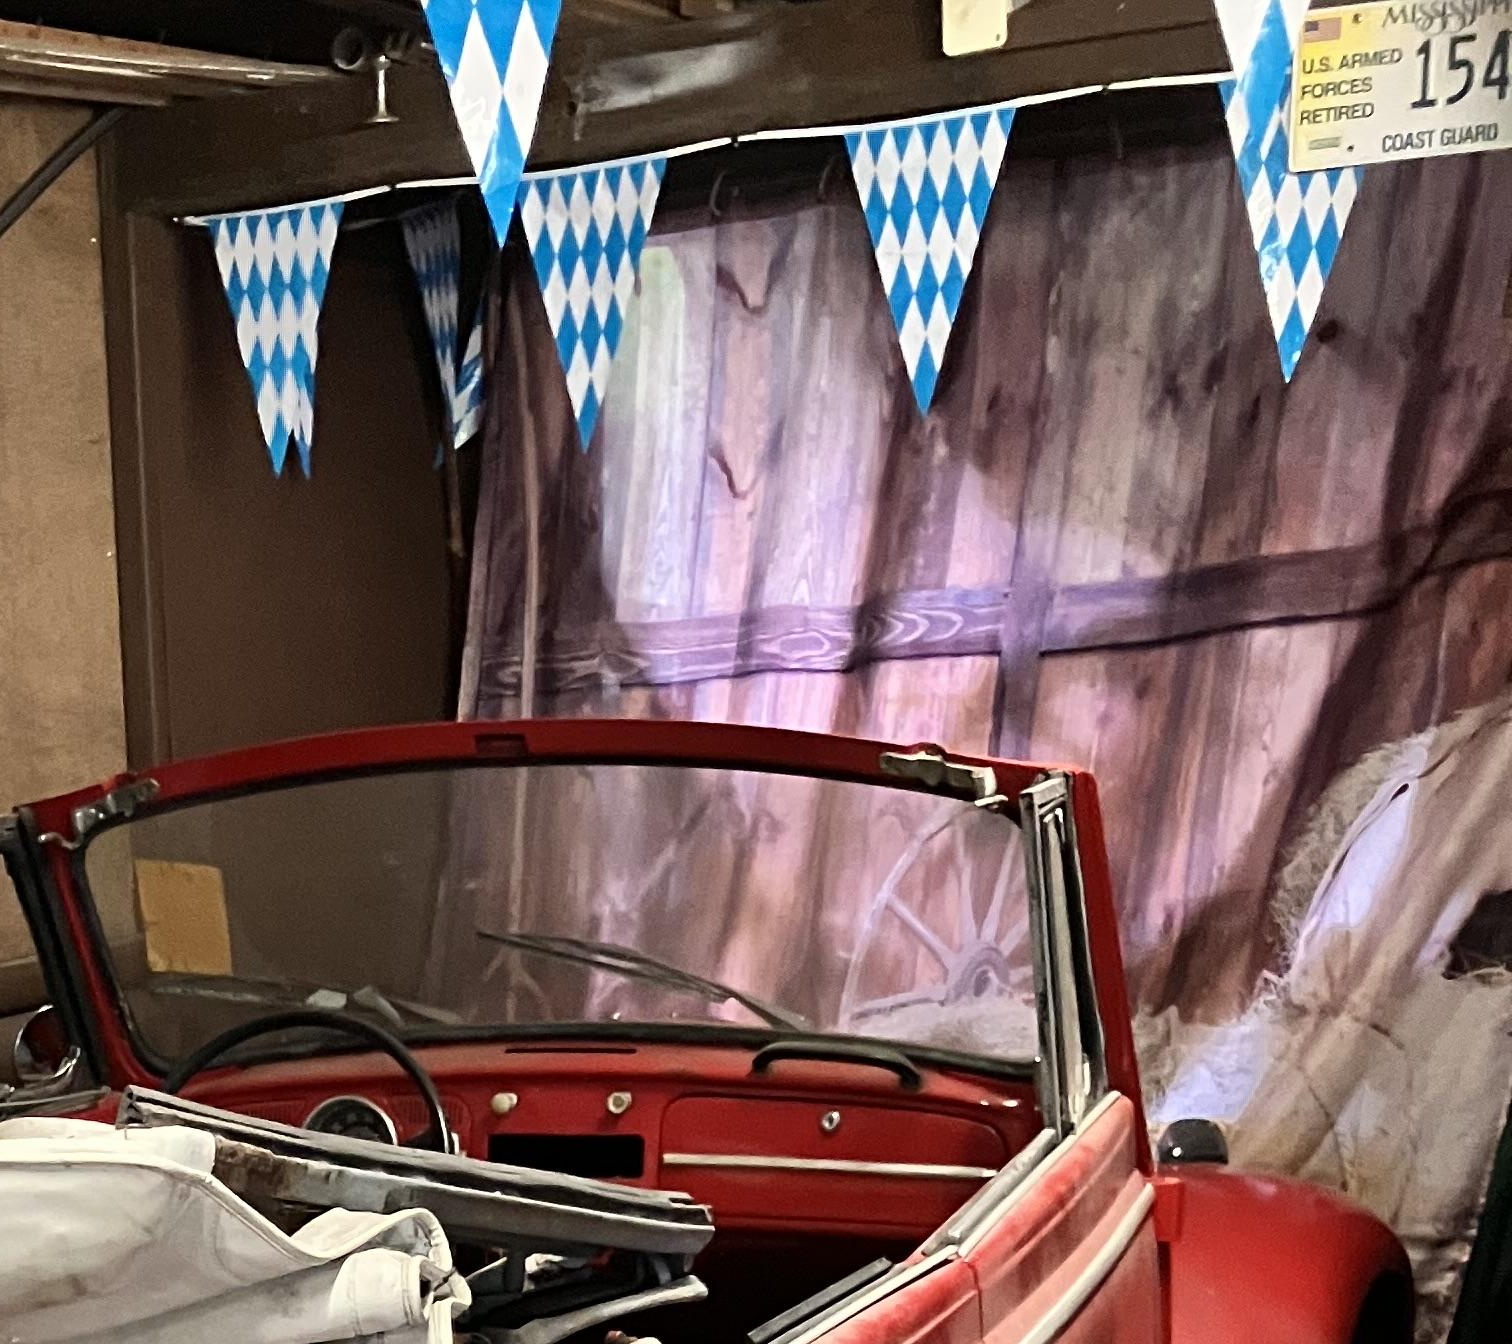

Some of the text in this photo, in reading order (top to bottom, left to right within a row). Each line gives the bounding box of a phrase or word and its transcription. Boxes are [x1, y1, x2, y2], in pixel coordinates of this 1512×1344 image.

[1301, 48, 1403, 75] U.S. ARMED
[1301, 77, 1373, 99] FORCES
[1299, 103, 1375, 125] RETIRED
[1382, 123, 1499, 153] COAST GUARD
